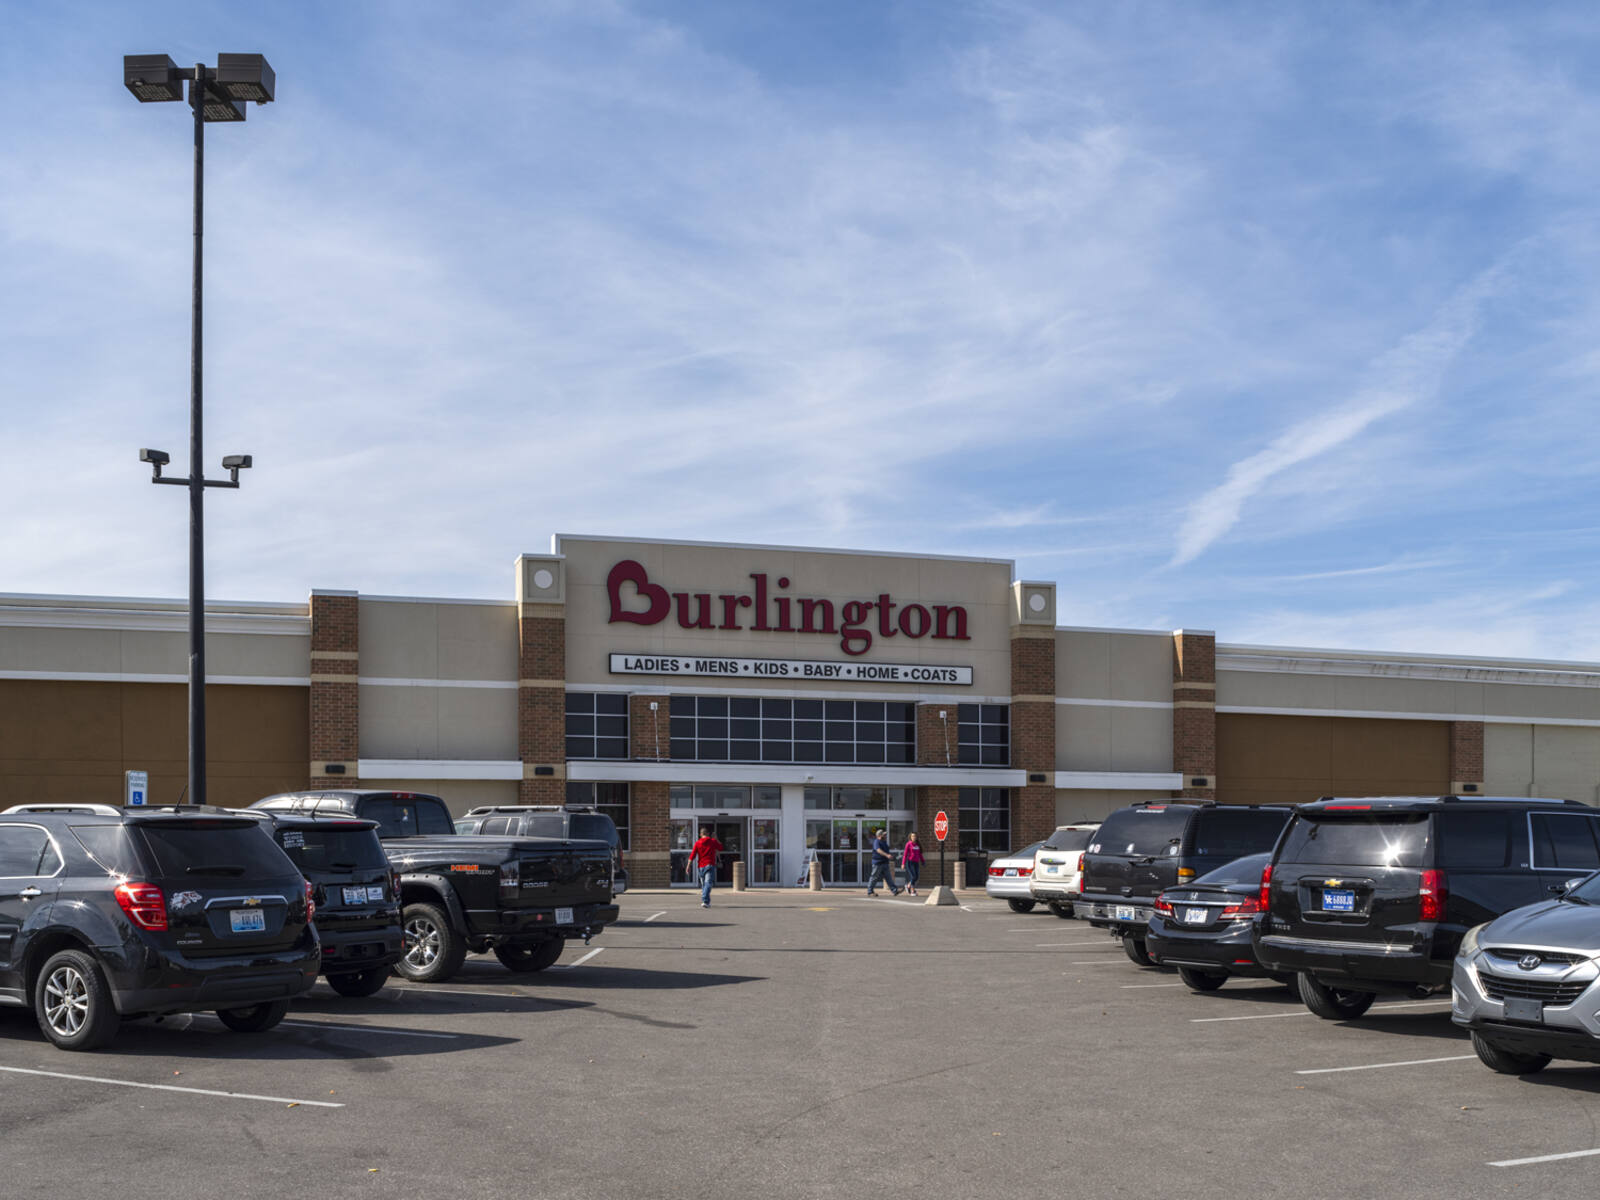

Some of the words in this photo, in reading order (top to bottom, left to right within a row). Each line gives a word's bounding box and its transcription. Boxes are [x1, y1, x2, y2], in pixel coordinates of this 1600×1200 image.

[607, 560, 971, 656] Burlington
[624, 658, 679, 671] LADIES
[695, 661, 739, 673] MENS
[754, 662, 788, 675] KIDS
[803, 664, 842, 676] BABY
[857, 666, 899, 679] HOME
[911, 668, 957, 681] COATS
[935, 820, 948, 832] STOP
